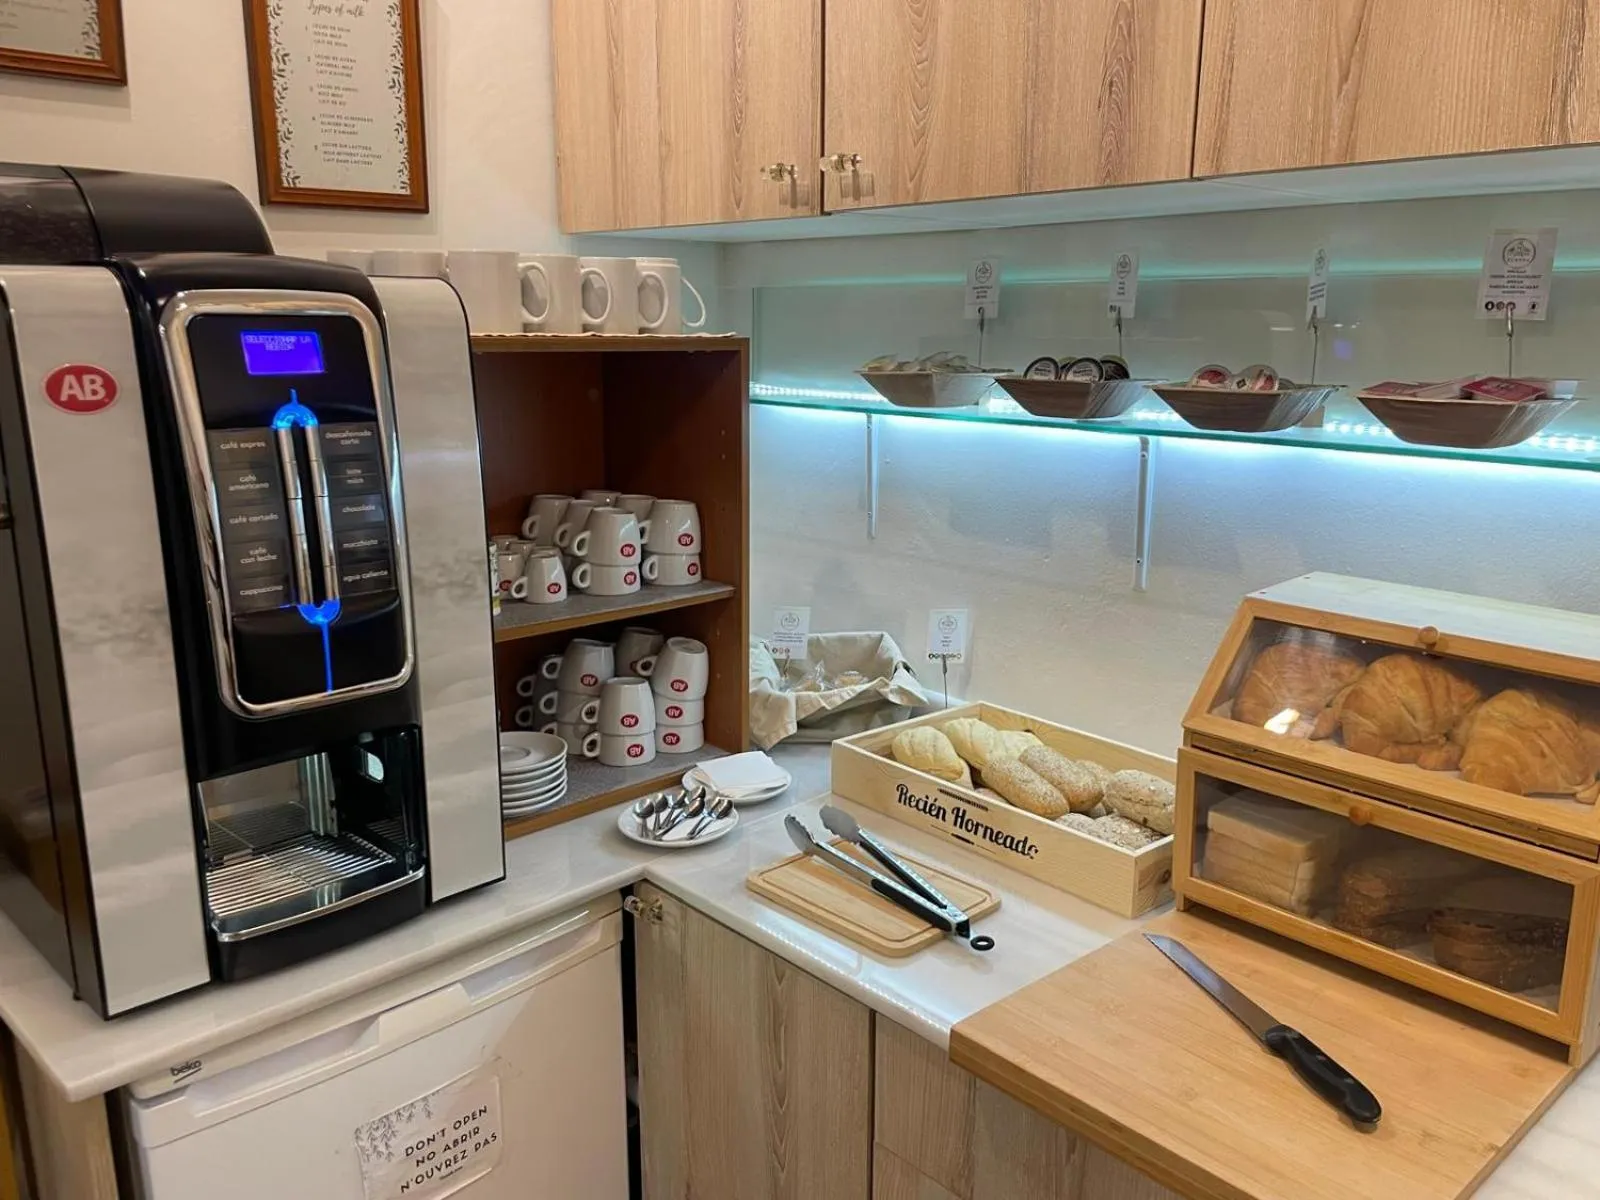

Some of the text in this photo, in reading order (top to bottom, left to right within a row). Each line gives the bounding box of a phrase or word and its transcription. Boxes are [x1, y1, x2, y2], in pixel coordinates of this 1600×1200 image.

[60, 374, 106, 402] AB
[896, 784, 946, 822] Recién
[170, 1060, 202, 1076] beko
[404, 1105, 488, 1157] DON'T OPEN
[416, 1126, 480, 1168] NO ABRIR
[400, 1149, 468, 1194] N'OUVREZ
[474, 1132, 498, 1152] PAS
